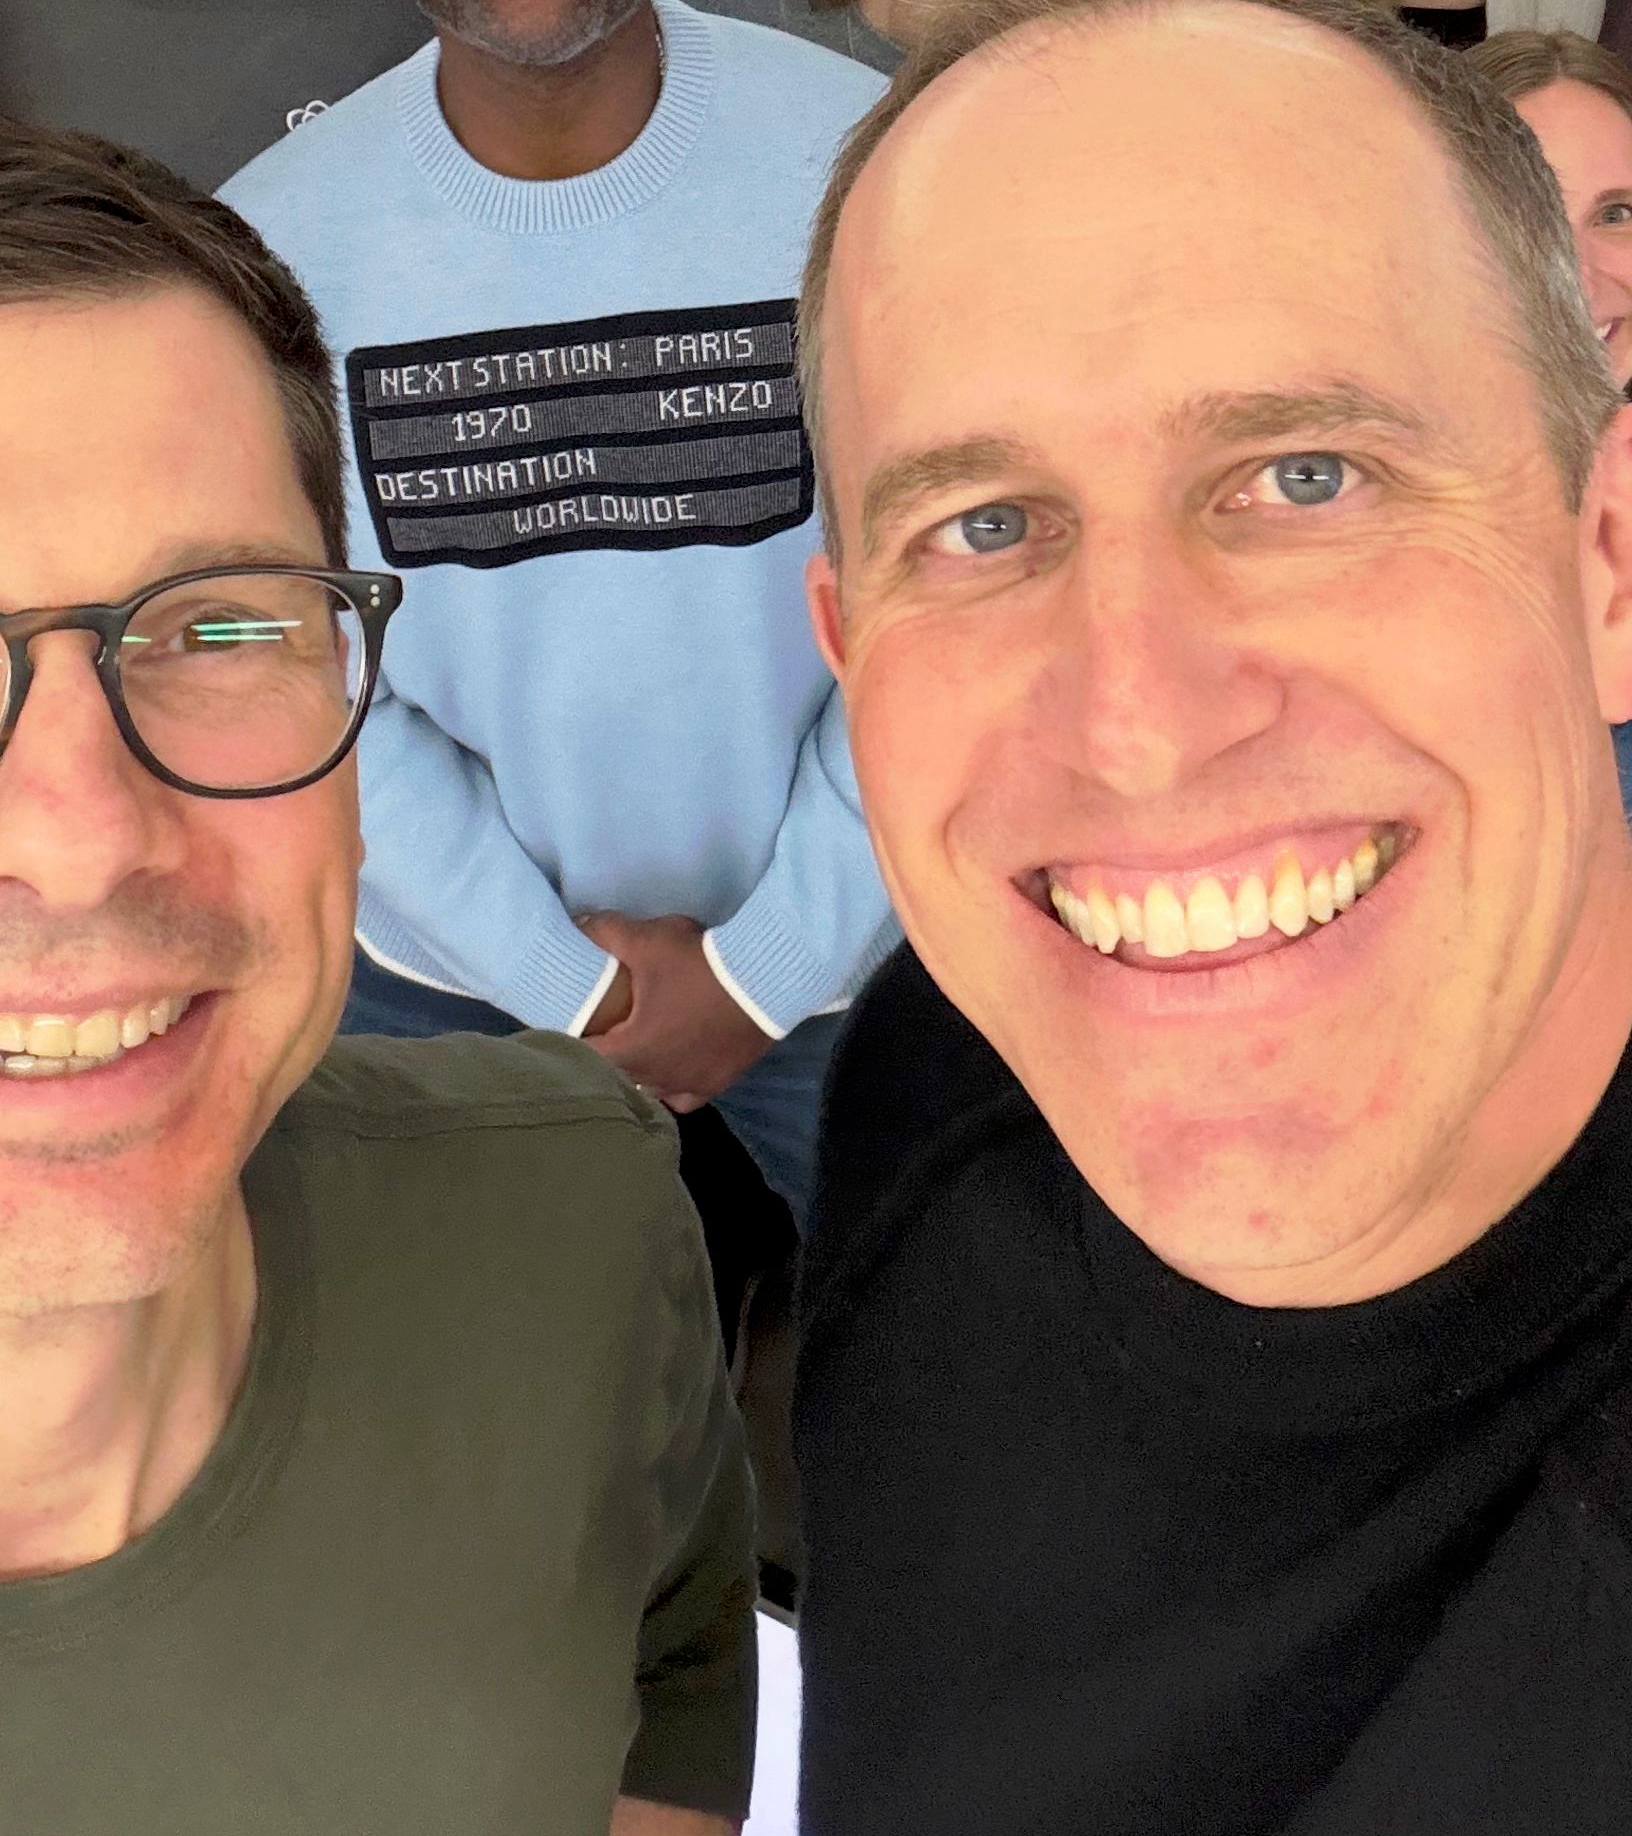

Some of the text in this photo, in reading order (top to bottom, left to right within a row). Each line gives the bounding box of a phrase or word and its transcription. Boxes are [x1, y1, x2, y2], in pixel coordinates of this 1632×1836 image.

[378, 328, 755, 399] NEXT STATION: PARIS
[451, 379, 774, 443] 1970 KENZO
[375, 447, 598, 502] DESTINATION
[512, 493, 698, 535] WORLDWIDE
